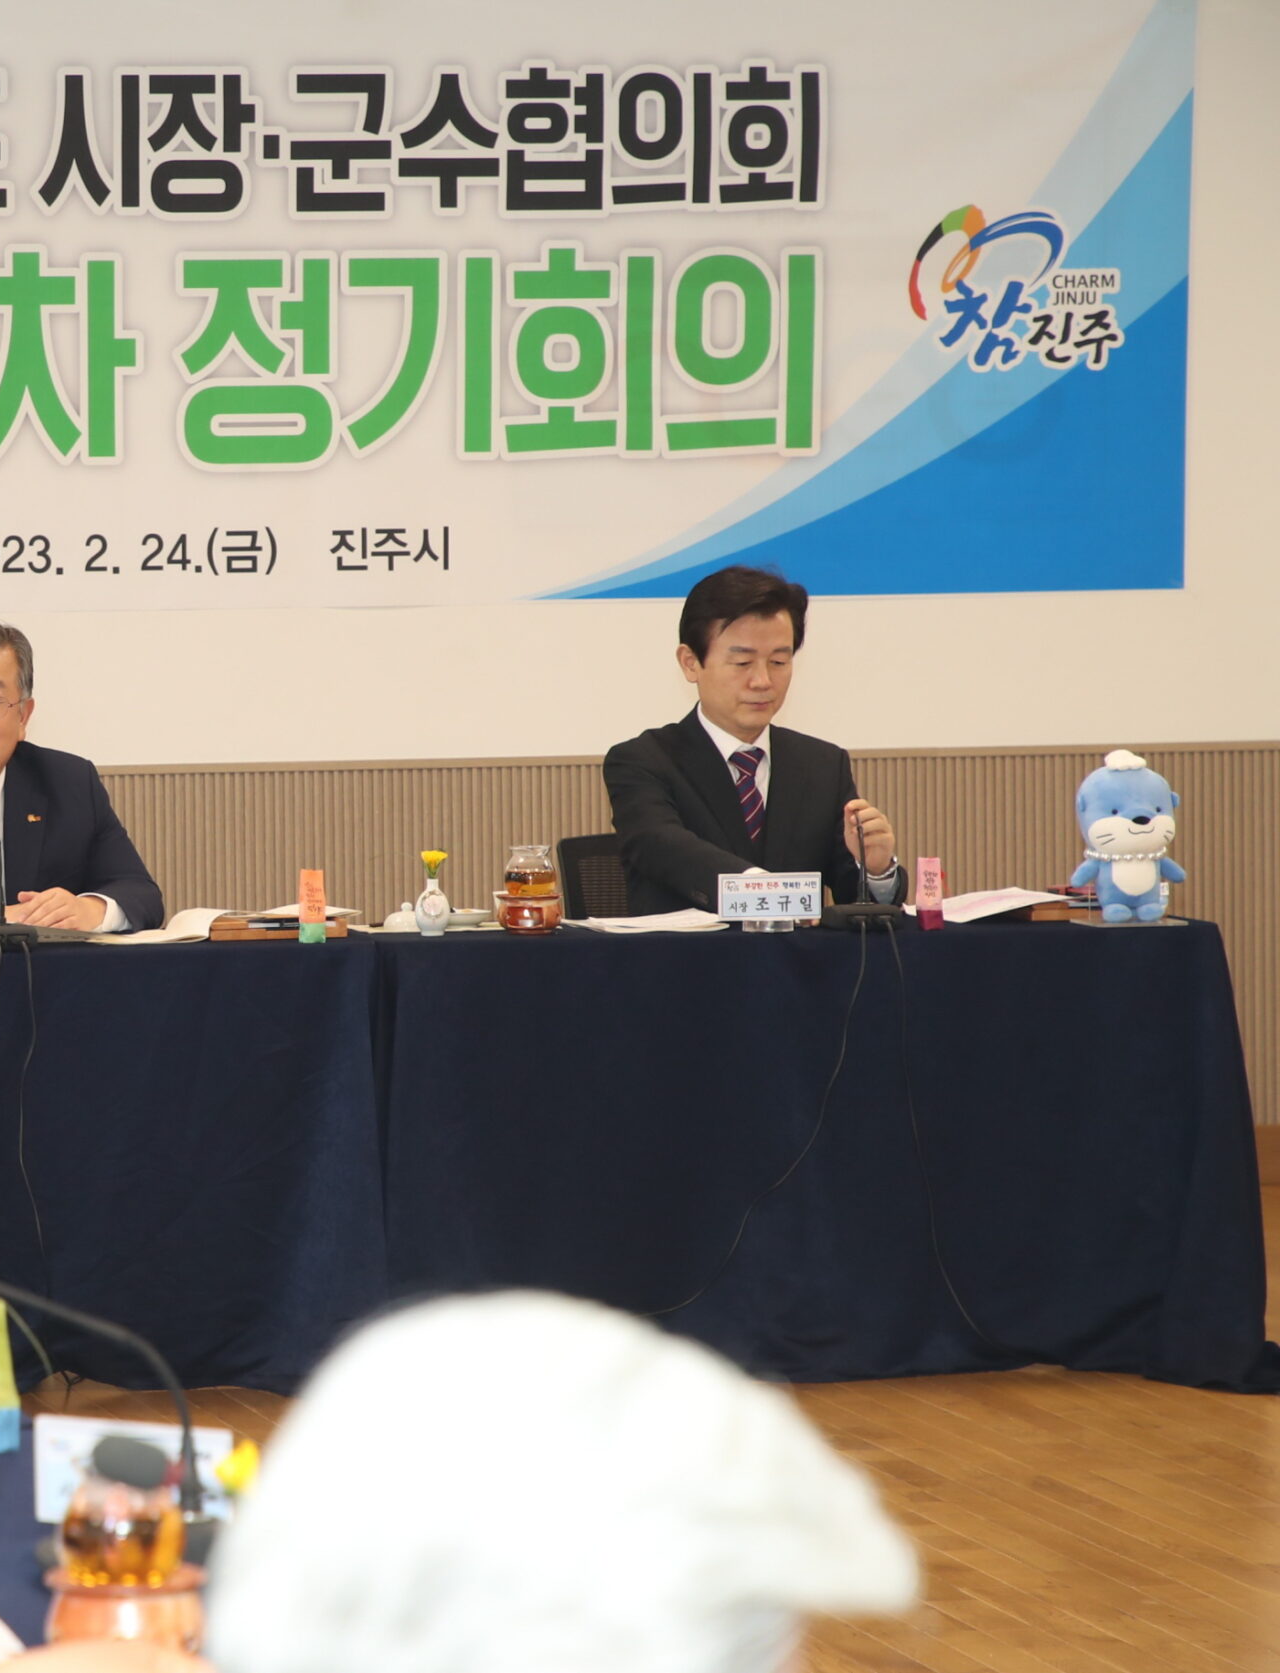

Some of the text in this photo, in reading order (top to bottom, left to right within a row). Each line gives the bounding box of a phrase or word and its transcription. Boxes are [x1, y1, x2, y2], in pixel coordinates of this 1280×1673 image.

[37, 65, 821, 215] 시장·군수협의회
[1051, 273, 1116, 290] CHARM
[1051, 290, 1097, 306] JINJU
[180, 247, 816, 465] 정기회의
[83, 533, 121, 575] 2.
[140, 526, 279, 576] 24.(금)
[328, 525, 451, 572] 진주시
[729, 894, 813, 912] 시장 조규일
